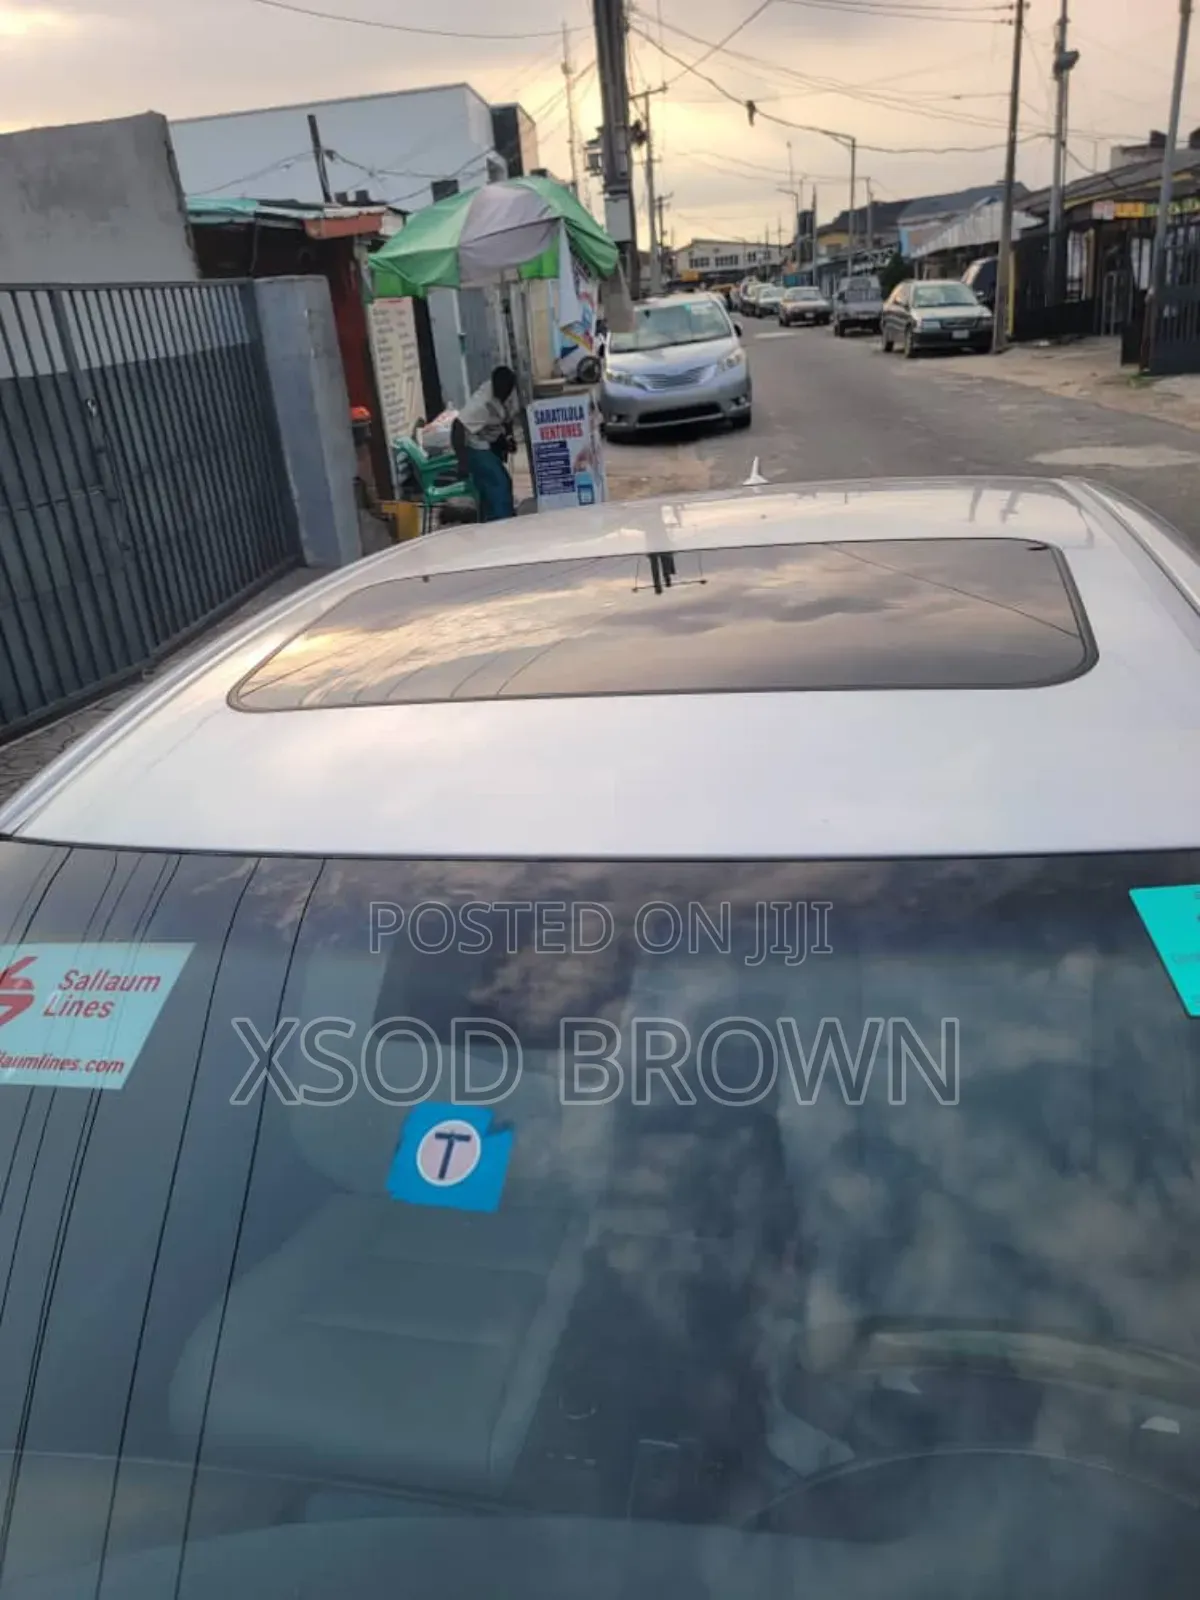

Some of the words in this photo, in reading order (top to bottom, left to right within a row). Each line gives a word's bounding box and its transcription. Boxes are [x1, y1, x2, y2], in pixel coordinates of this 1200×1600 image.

[538, 423, 584, 440] VENTURES
[57, 969, 161, 993] Sallaum
[43, 994, 115, 1018] Lines
[434, 1129, 472, 1180] T
